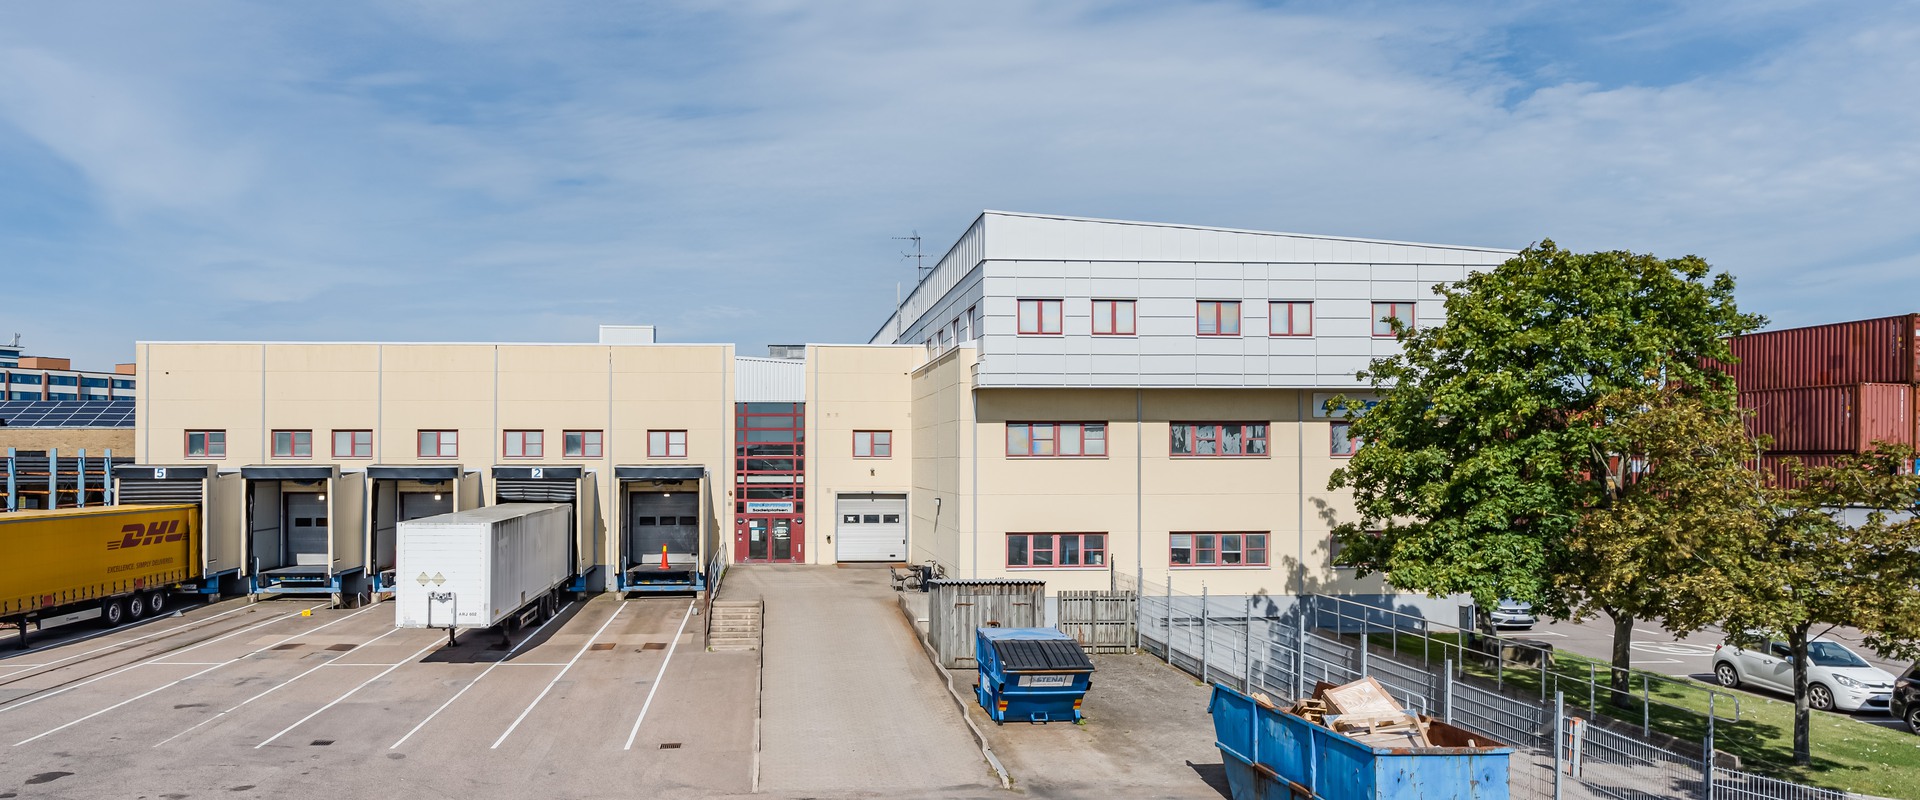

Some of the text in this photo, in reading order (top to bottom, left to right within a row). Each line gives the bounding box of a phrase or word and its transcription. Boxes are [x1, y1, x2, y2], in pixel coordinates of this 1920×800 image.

[157, 468, 164, 478] 5
[534, 468, 541, 477] 2
[120, 520, 182, 548] DHL
[136, 560, 151, 569] SIMPLY
